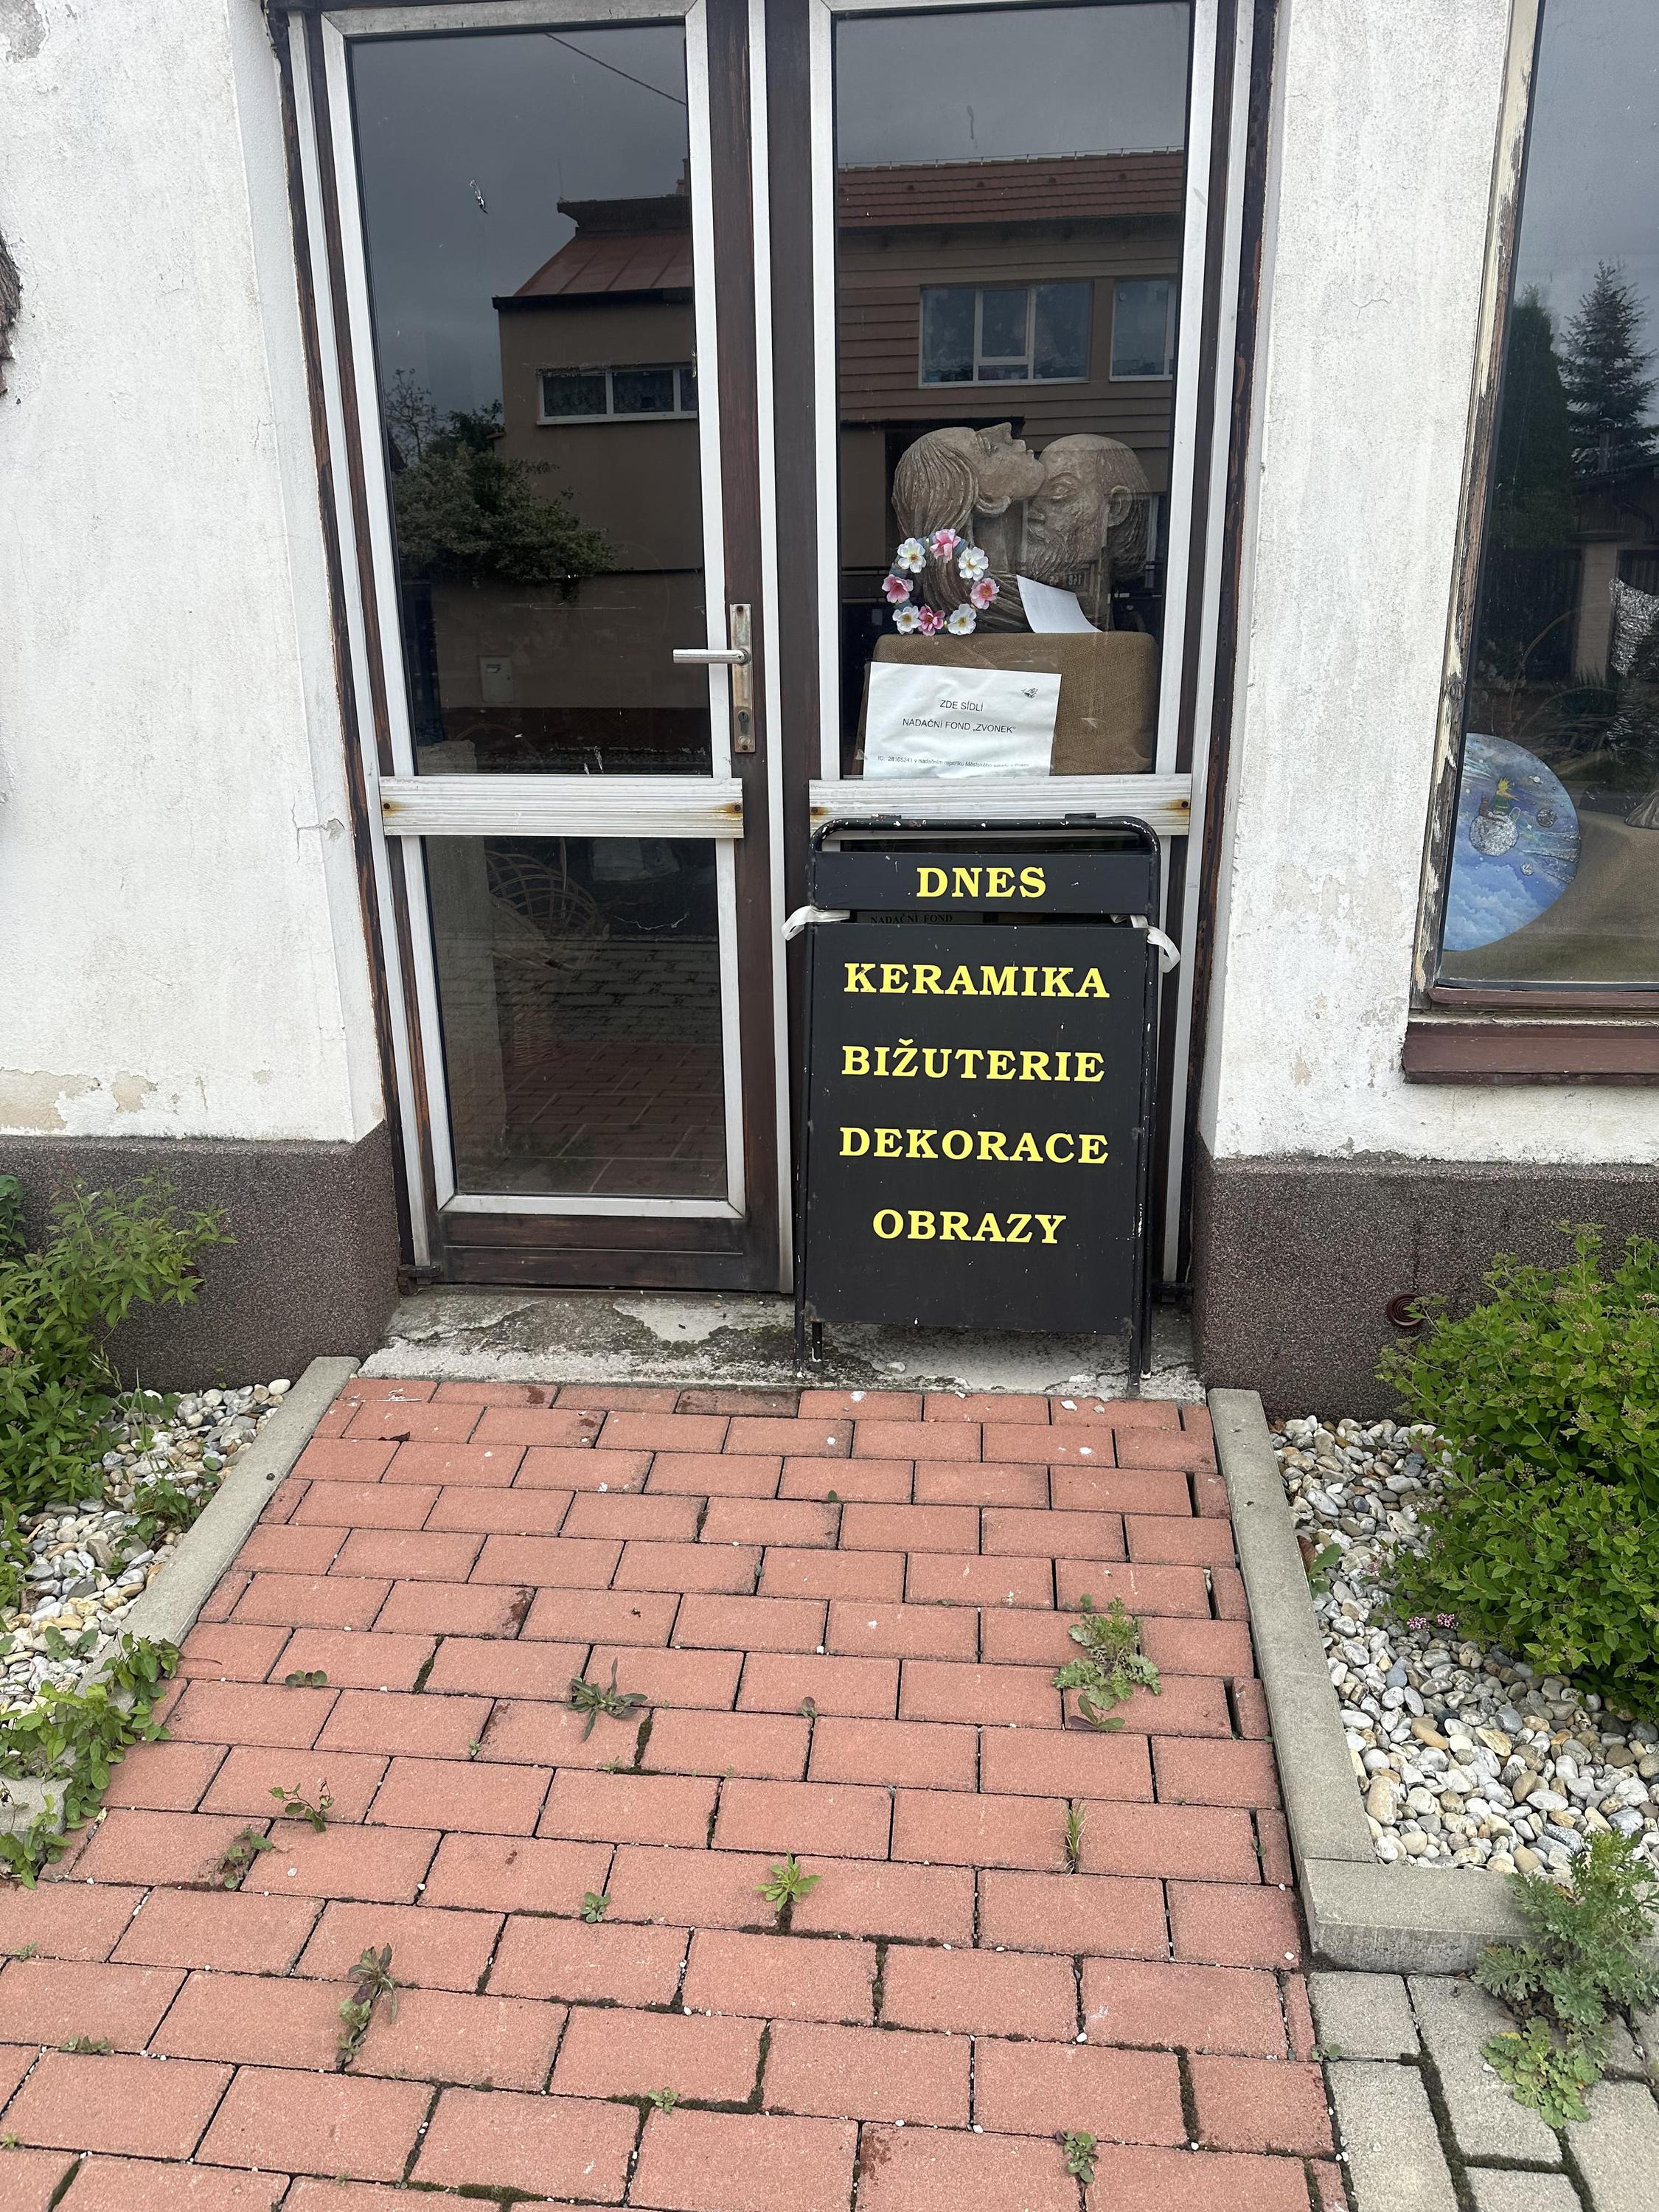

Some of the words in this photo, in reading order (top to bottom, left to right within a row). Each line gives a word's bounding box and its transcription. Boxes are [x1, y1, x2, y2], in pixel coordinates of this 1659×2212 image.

[939, 700, 959, 709] ZDE
[960, 700, 984, 712] SÍDLÍ
[902, 718, 943, 728] NADAČNÍ
[945, 721, 971, 731] FOND
[916, 866, 1047, 899] DNES
[871, 913, 918, 924] NADAČNÍ
[924, 914, 953, 923] FOND
[844, 962, 1110, 998] KERAMIKA
[841, 1038, 1106, 1082] BIŽUTERIE
[838, 1126, 1109, 1165] DEKORACE
[872, 1208, 1067, 1244] OBRAZY
